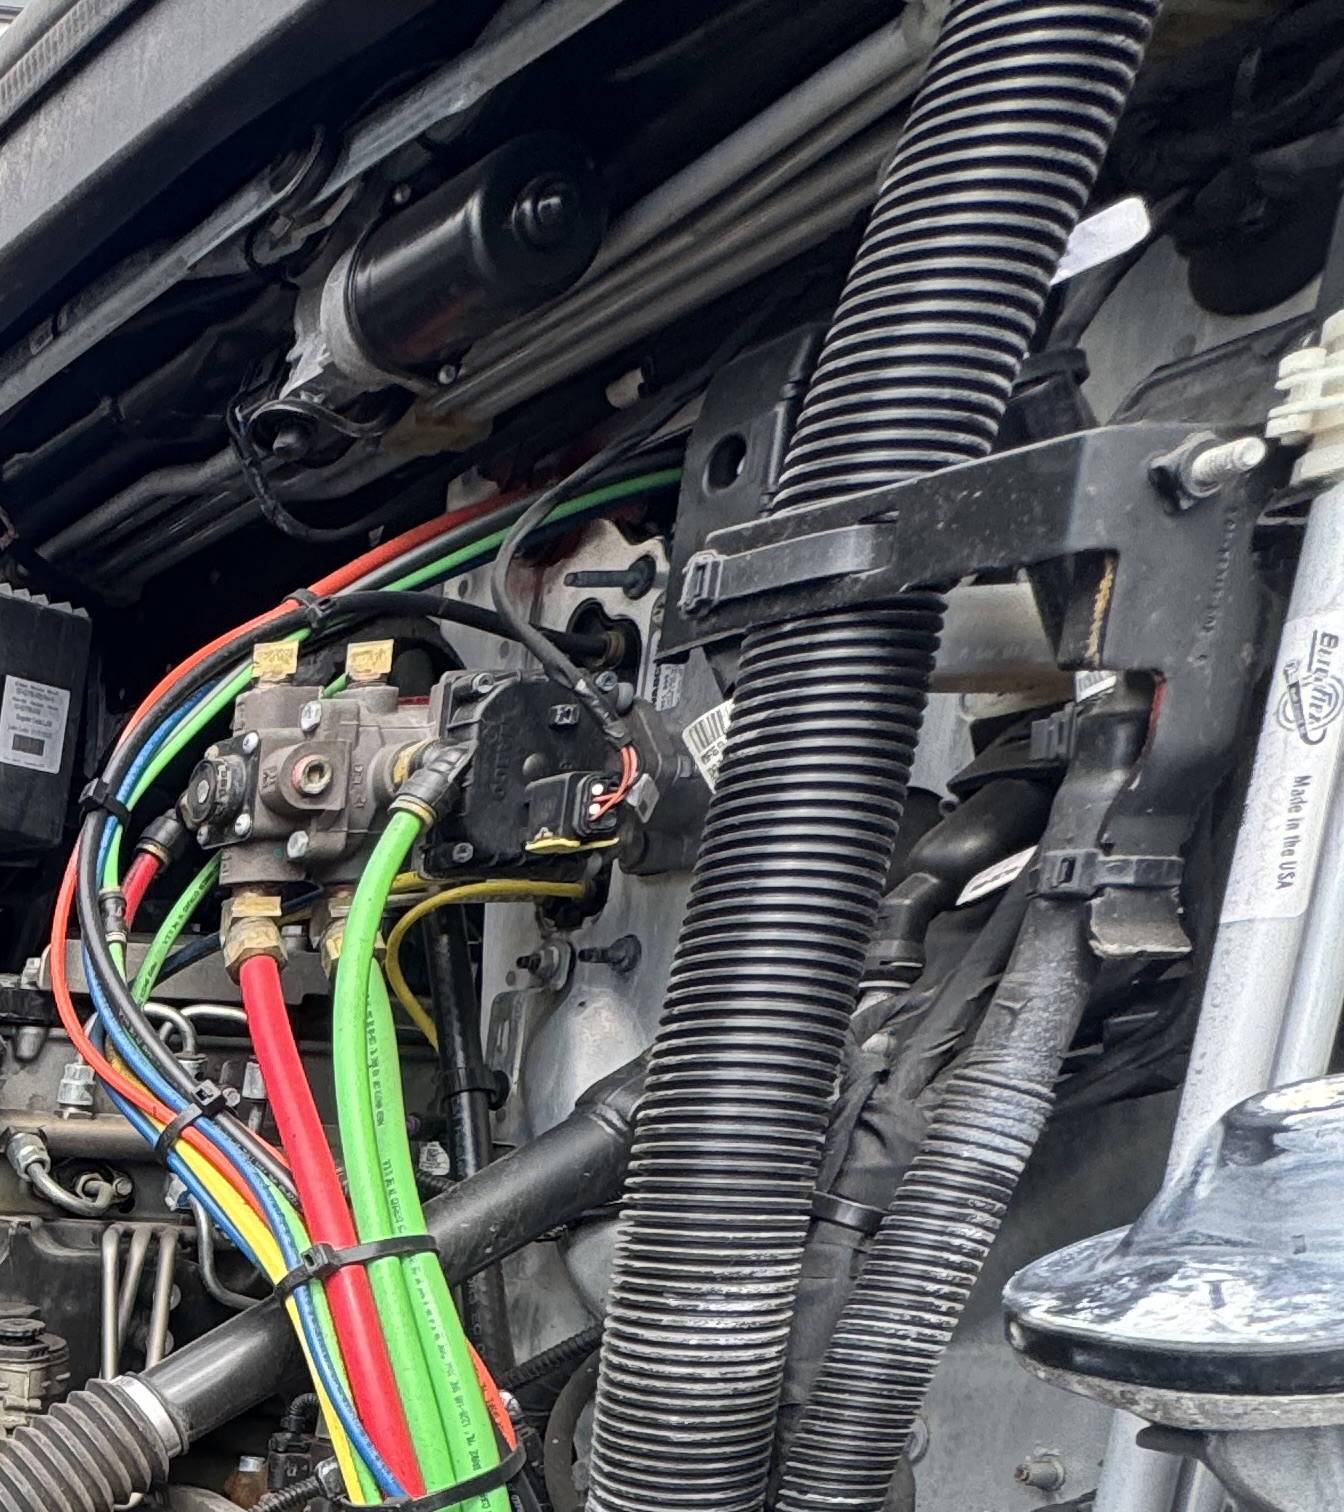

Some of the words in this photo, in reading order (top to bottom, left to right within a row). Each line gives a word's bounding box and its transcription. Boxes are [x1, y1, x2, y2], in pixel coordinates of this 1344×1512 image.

[1288, 774, 1312, 813] Made
[1285, 817, 1302, 831] in
[1280, 834, 1301, 857] the
[1275, 861, 1297, 890] USA
